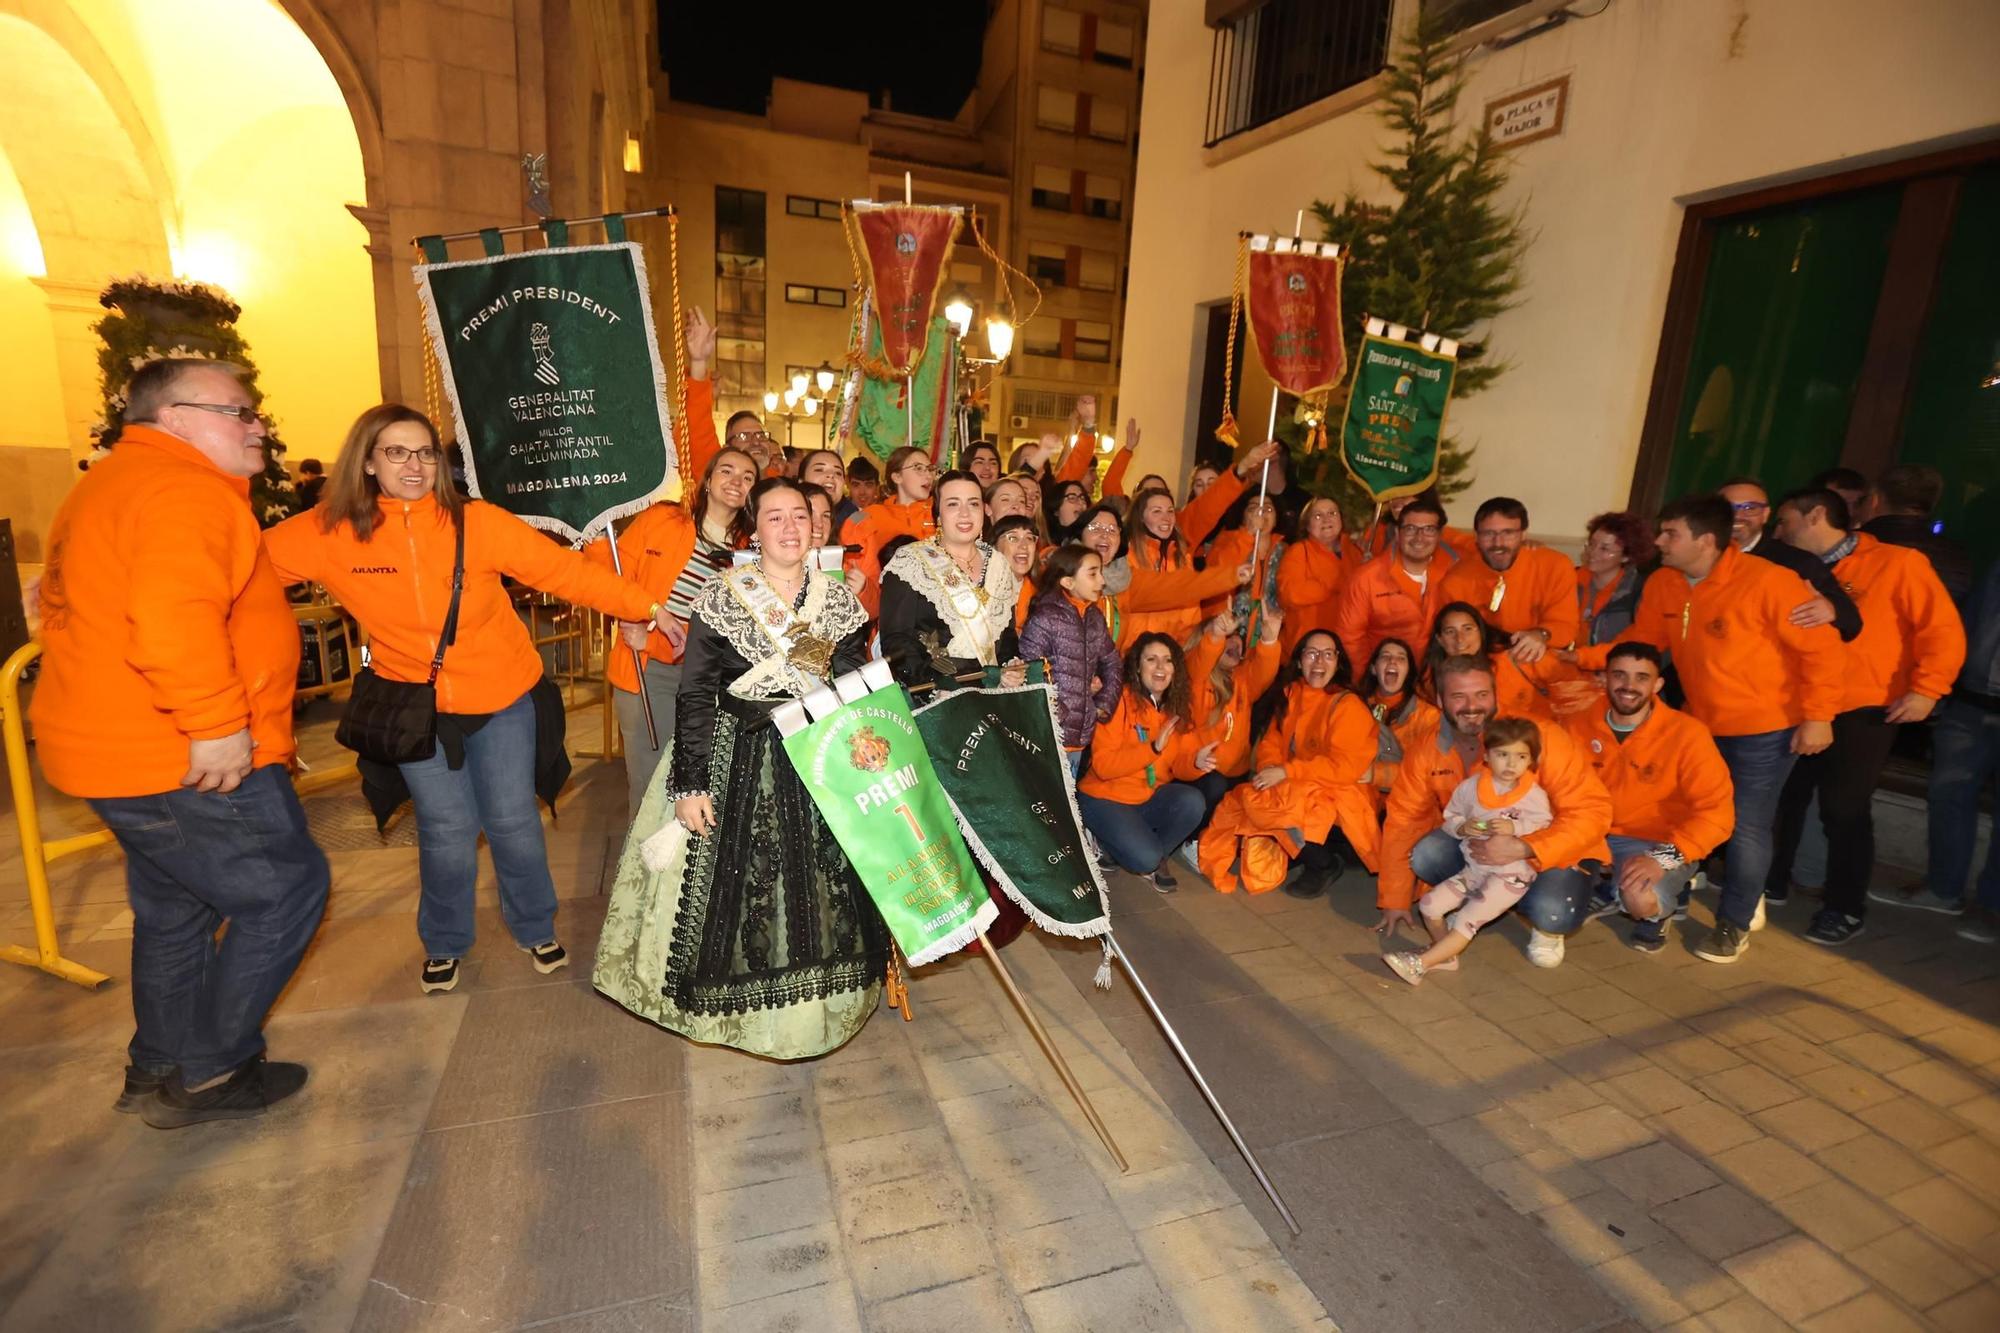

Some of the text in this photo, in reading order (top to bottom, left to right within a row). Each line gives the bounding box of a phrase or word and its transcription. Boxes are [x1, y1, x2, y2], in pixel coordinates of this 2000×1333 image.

[1508, 100, 1542, 119] PLAÇA
[1504, 117, 1541, 136] MAJOR
[461, 286, 621, 341] PREMI PRESIDENT
[508, 389, 596, 409] GENERALITAT
[513, 404, 596, 422] VALENCIANA
[539, 426, 574, 438] MILLOR
[509, 435, 614, 456] GAIATA INFANTIL
[506, 471, 628, 494] MAGDALENA 2024
[850, 708, 865, 720] DE
[957, 719, 990, 772] PREMI
[854, 763, 919, 816] PREMI
[893, 802, 926, 843] 1
